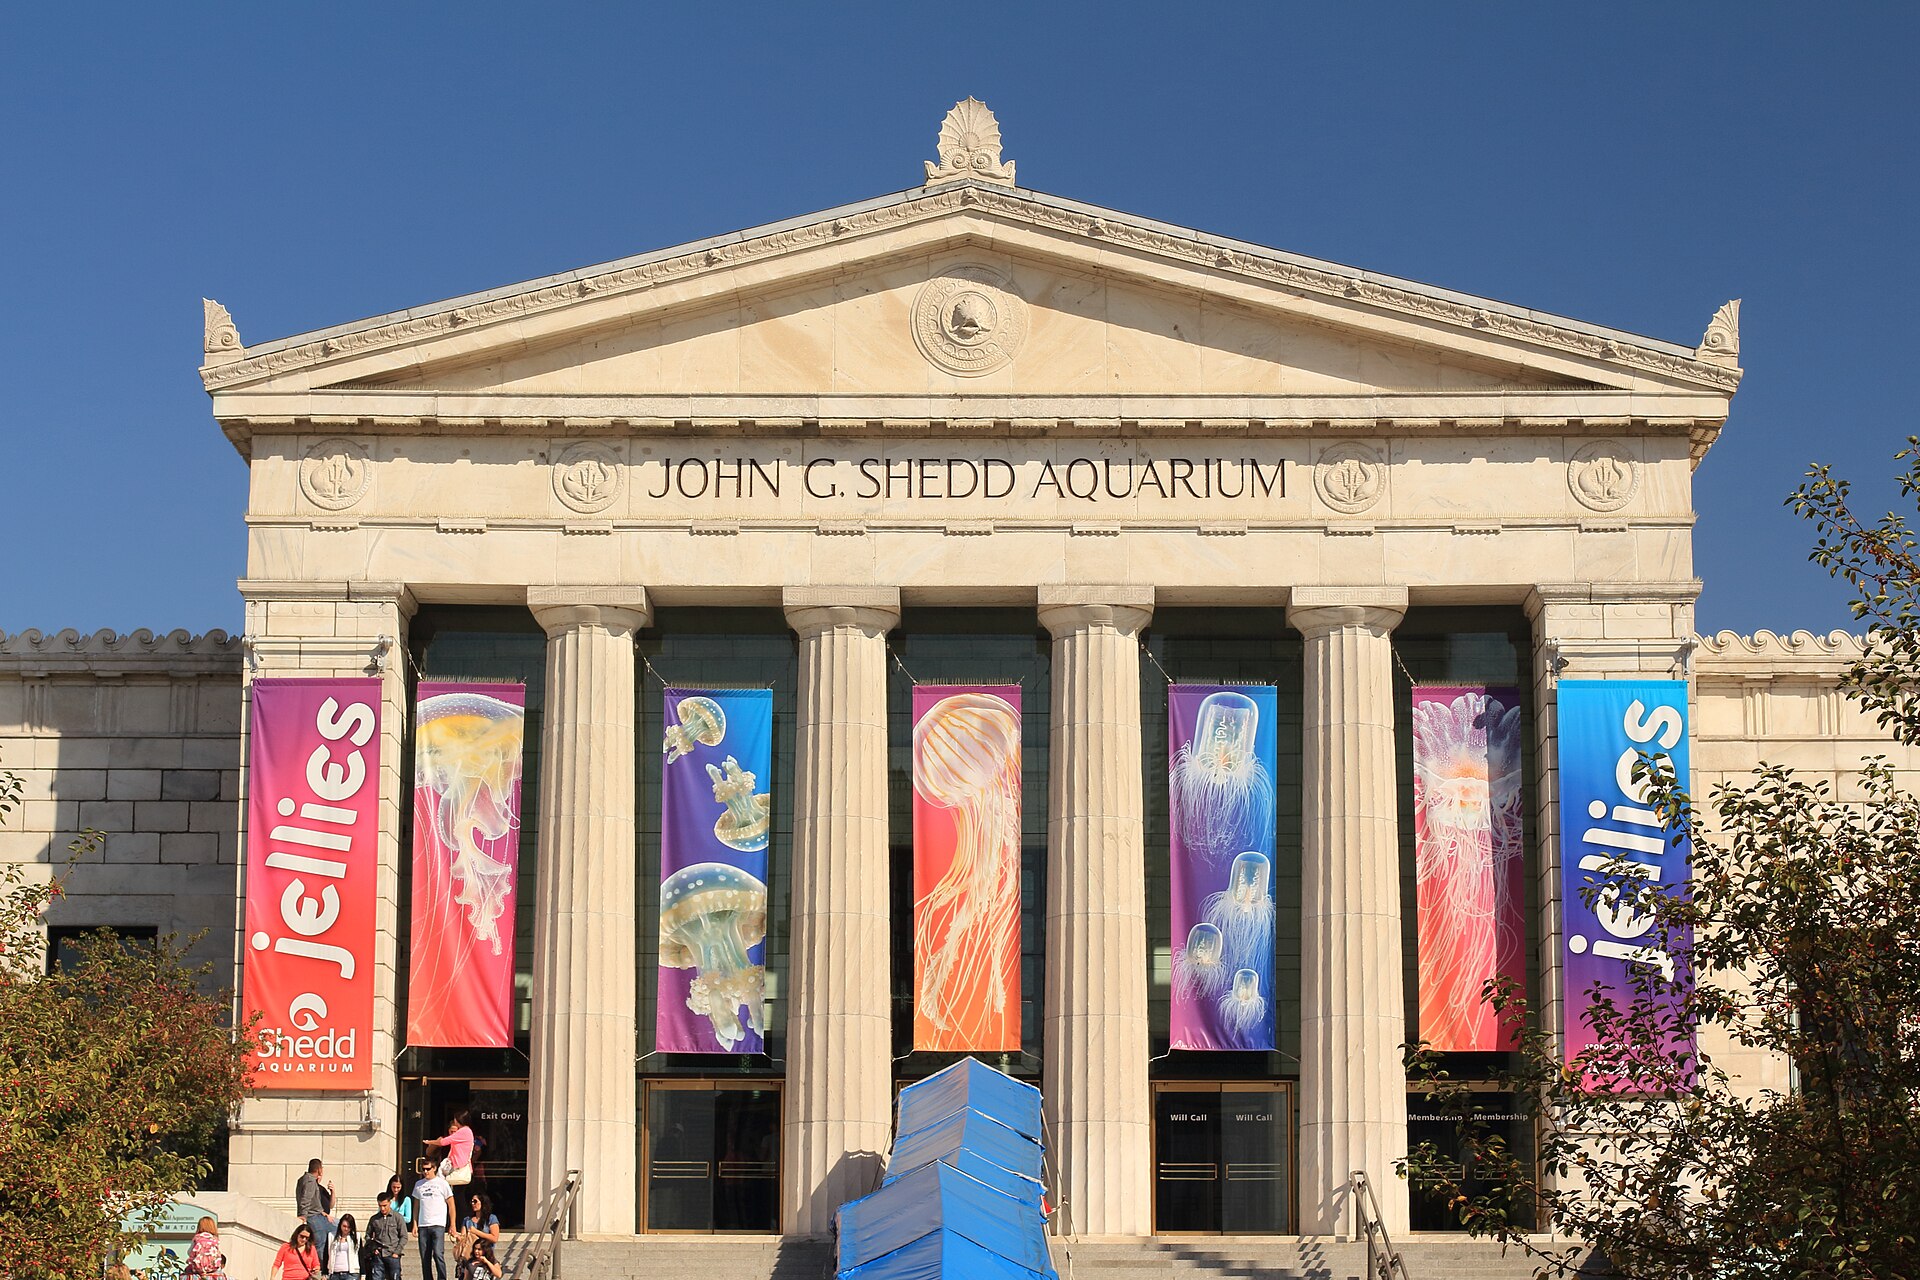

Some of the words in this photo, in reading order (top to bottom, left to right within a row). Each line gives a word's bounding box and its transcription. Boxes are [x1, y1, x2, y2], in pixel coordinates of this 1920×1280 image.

[648, 457, 781, 498] JOHN
[803, 457, 845, 499] G.
[856, 457, 1016, 499] SHEDD
[1031, 458, 1286, 502] AQUARIUM
[251, 695, 377, 980] jellies
[1568, 698, 1684, 983] jellies
[256, 1027, 357, 1059] Shedd
[257, 1062, 354, 1073] AQUARIUM
[481, 1112, 498, 1120] Exit
[500, 1112, 521, 1122] Only
[1473, 1113, 1529, 1122] Membership
